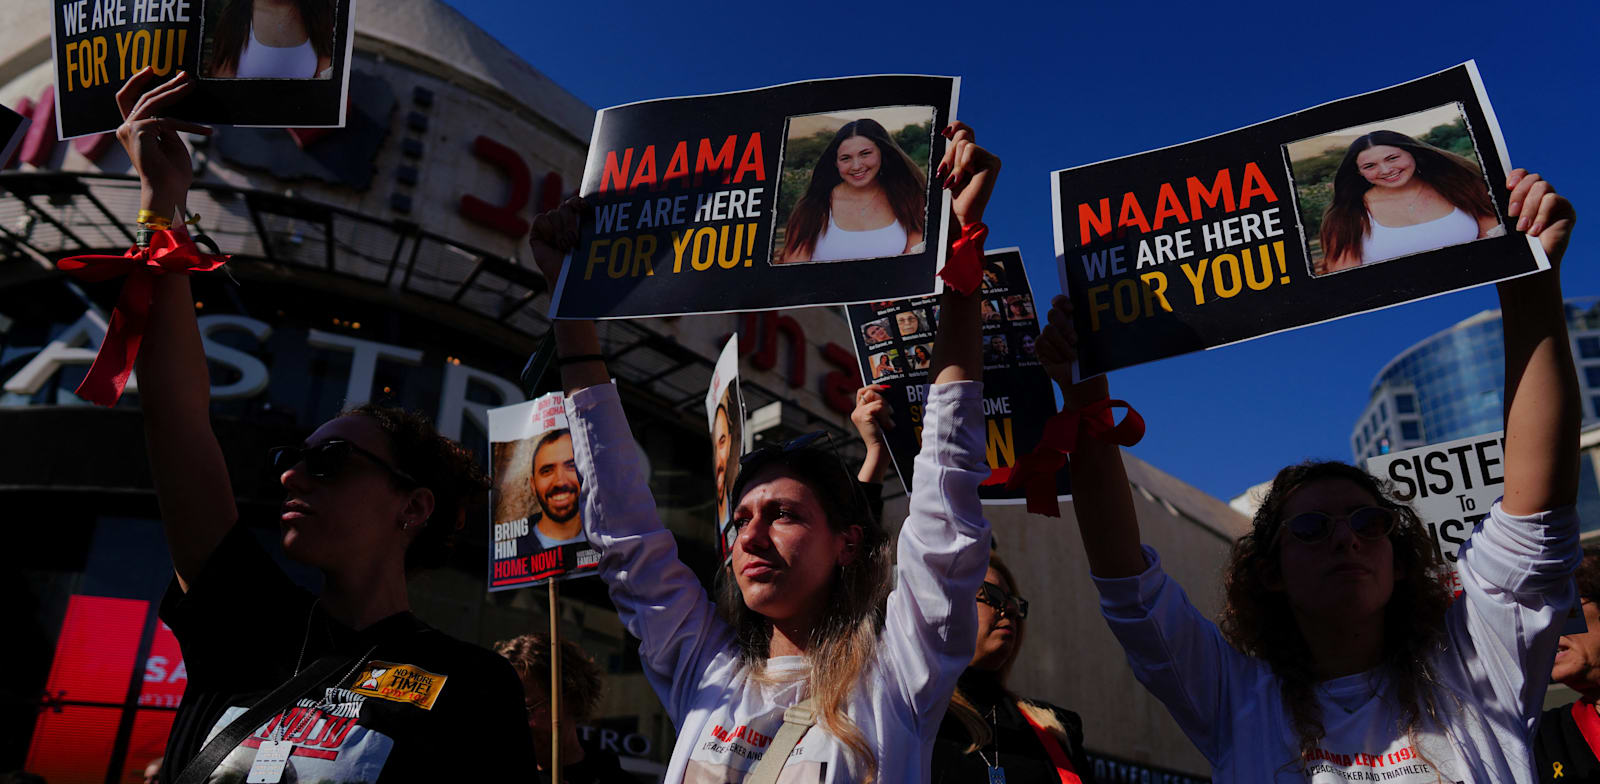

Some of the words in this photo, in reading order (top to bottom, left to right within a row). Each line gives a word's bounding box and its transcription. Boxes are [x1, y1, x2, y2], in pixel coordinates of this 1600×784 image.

[63, 0, 88, 37] WE
[91, 0, 126, 31] ARE
[133, 0, 190, 24] HERE
[65, 35, 110, 92] FOR
[115, 28, 188, 81] YOU!
[599, 131, 767, 199] NAAMA
[594, 201, 633, 234] WE
[635, 194, 688, 230] ARE
[694, 187, 764, 223] HERE
[1077, 161, 1279, 248] NAAMA
[583, 234, 657, 281] FOR
[671, 223, 758, 274] YOU!
[1081, 244, 1127, 282] WE
[1136, 228, 1195, 270] ARE
[1201, 207, 1284, 253] HERE
[1087, 270, 1174, 333] FOR
[1179, 240, 1291, 306] YOU!
[984, 396, 1012, 416] OME
[1388, 438, 1504, 502] SISTE
[1456, 494, 1476, 512] To
[494, 517, 529, 542] BRING
[494, 538, 517, 560] HIM
[494, 556, 529, 579] HOME
[391, 676, 433, 695] TIME!
[395, 668, 408, 677] NO
[409, 672, 433, 684] MORE
[1355, 752, 1384, 768] LEVY
[1366, 771, 1381, 782] AND
[1381, 764, 1430, 779] TRIATHLETE
